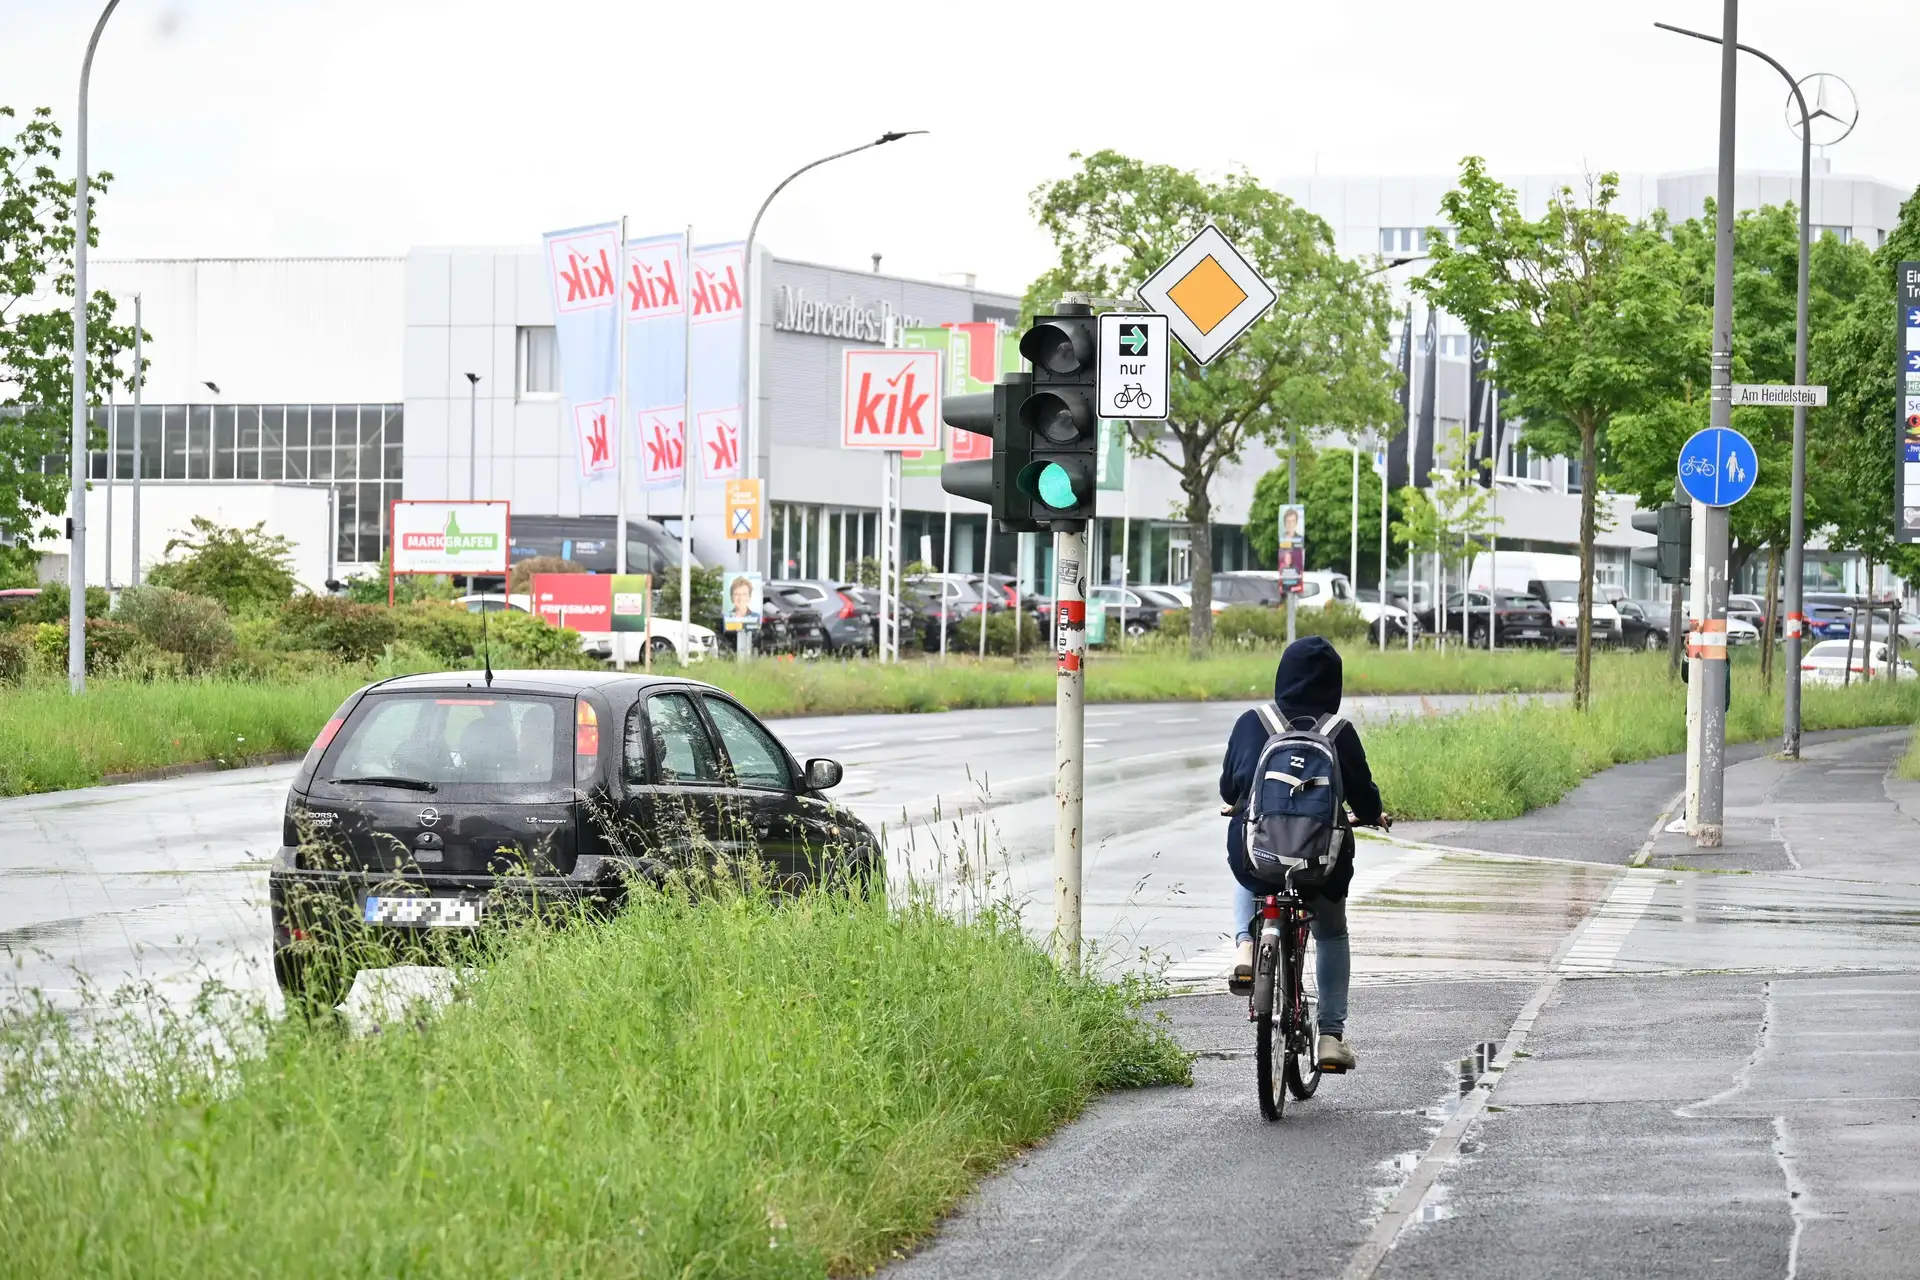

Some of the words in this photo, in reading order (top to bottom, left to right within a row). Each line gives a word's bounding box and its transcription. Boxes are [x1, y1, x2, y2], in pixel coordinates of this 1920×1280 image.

[1906, 285, 1920, 298] Tr
[1119, 364, 1146, 375] nur
[854, 362, 930, 435] kik
[1741, 388, 1759, 402] Am
[1761, 388, 1817, 405] Heidelsteig
[407, 535, 493, 548] MARKGRAFEN
